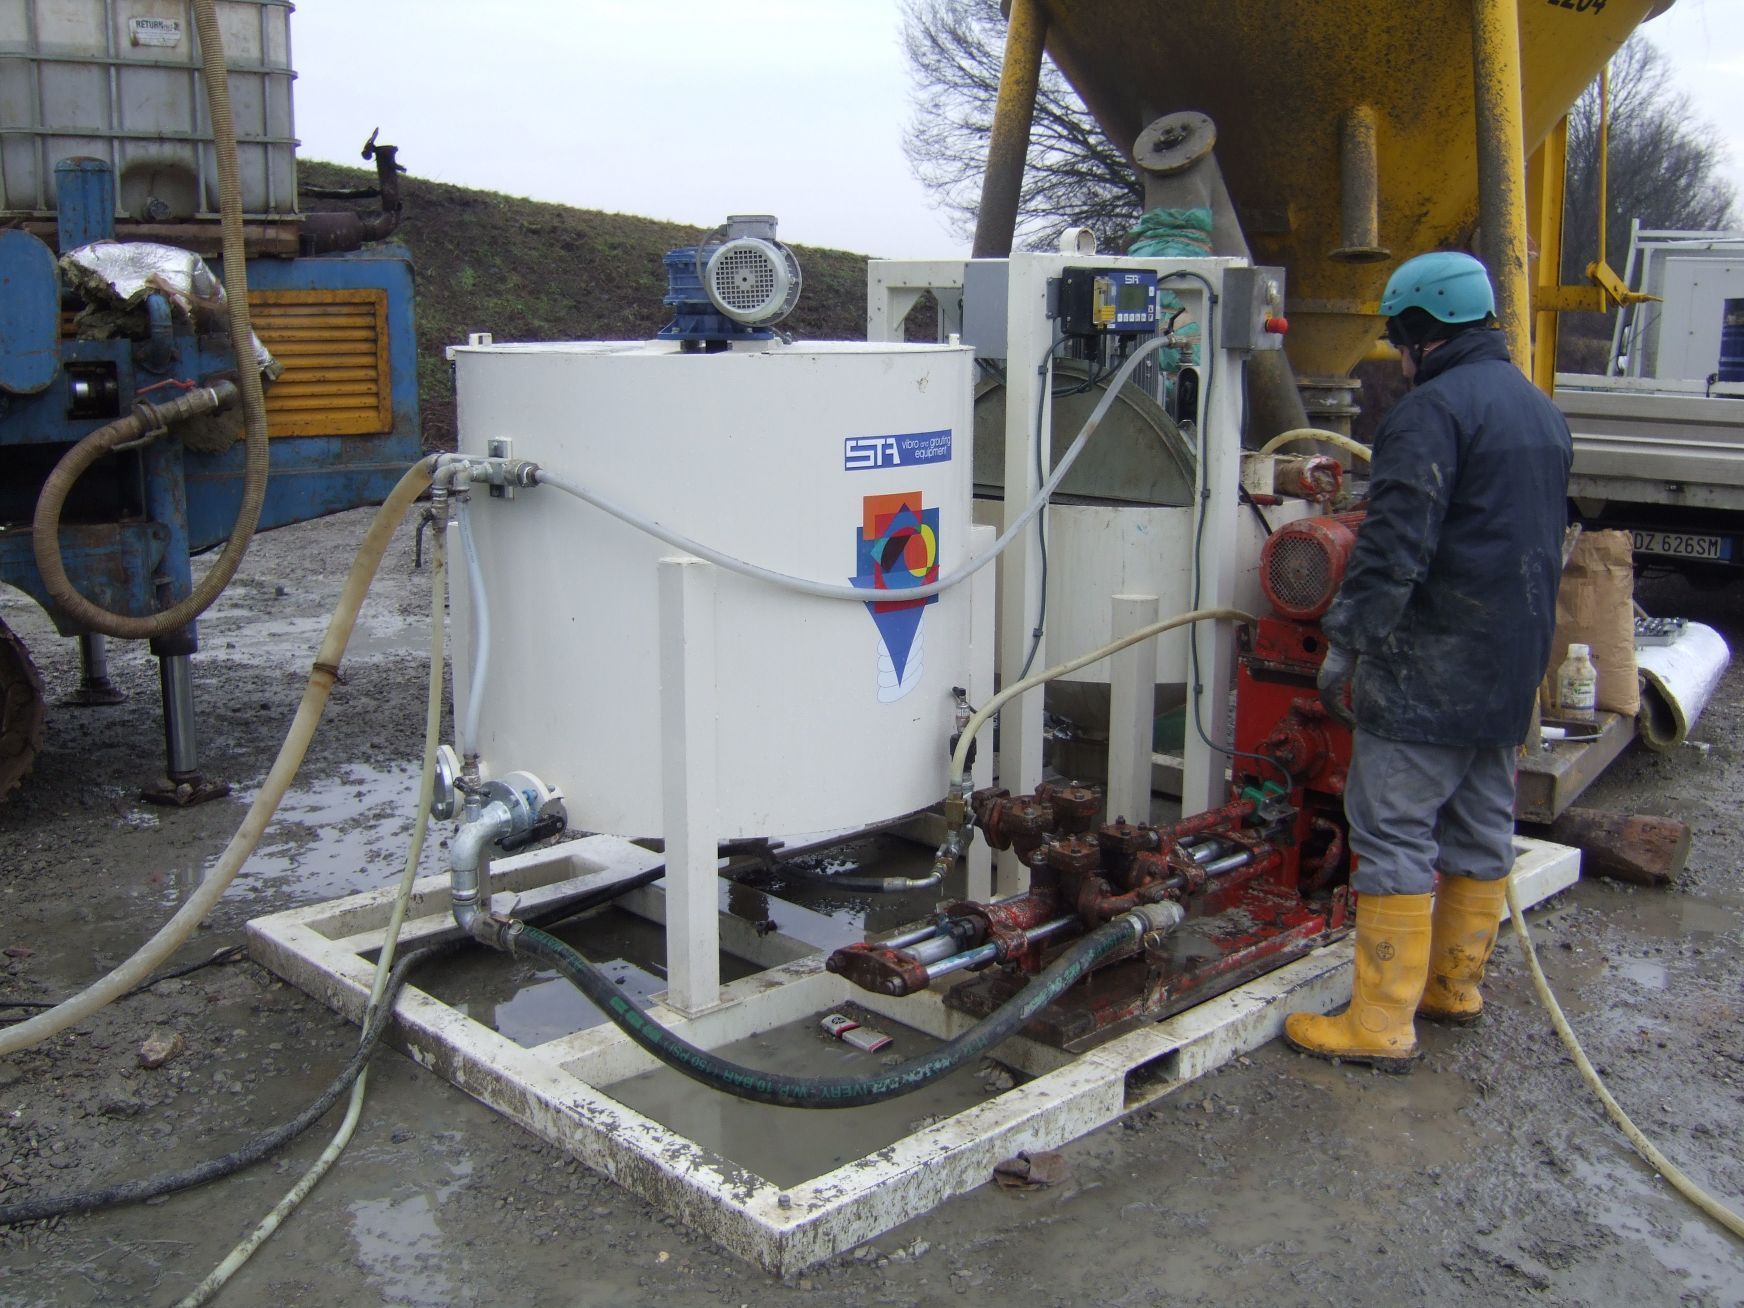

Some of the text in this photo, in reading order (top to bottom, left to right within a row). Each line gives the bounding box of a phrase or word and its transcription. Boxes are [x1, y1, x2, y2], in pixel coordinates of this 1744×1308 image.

[1547, 0, 1606, 15] 04
[845, 438, 900, 468] STA
[901, 440, 919, 449] vibro
[930, 435, 951, 449] grouting
[914, 446, 947, 460] equipment
[1634, 532, 1719, 556] DZ 626SM
[723, 1068, 753, 1089] BAR
